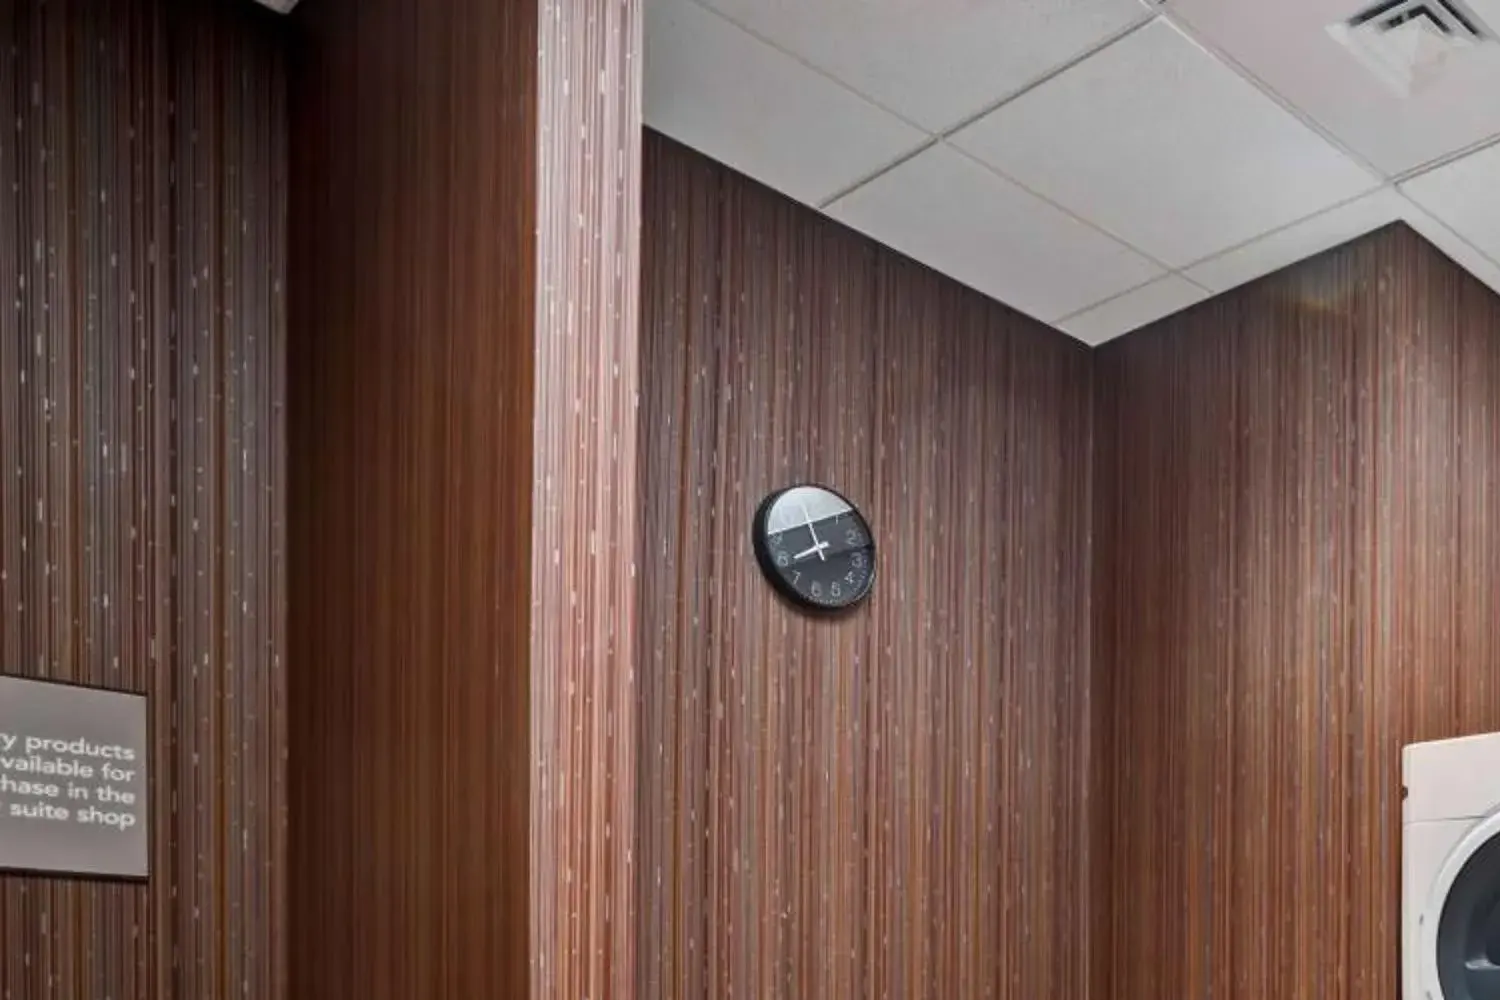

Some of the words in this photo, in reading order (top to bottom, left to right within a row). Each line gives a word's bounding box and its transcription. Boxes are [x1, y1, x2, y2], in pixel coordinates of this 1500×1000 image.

[852, 552, 863, 568] 3
[792, 570, 802, 585] 7
[844, 571, 855, 584] 4
[25, 735, 136, 761] products
[101, 763, 136, 782] for
[68, 782, 88, 799] in
[96, 786, 136, 805] the
[10, 802, 69, 821] suite
[77, 806, 136, 831] shop
